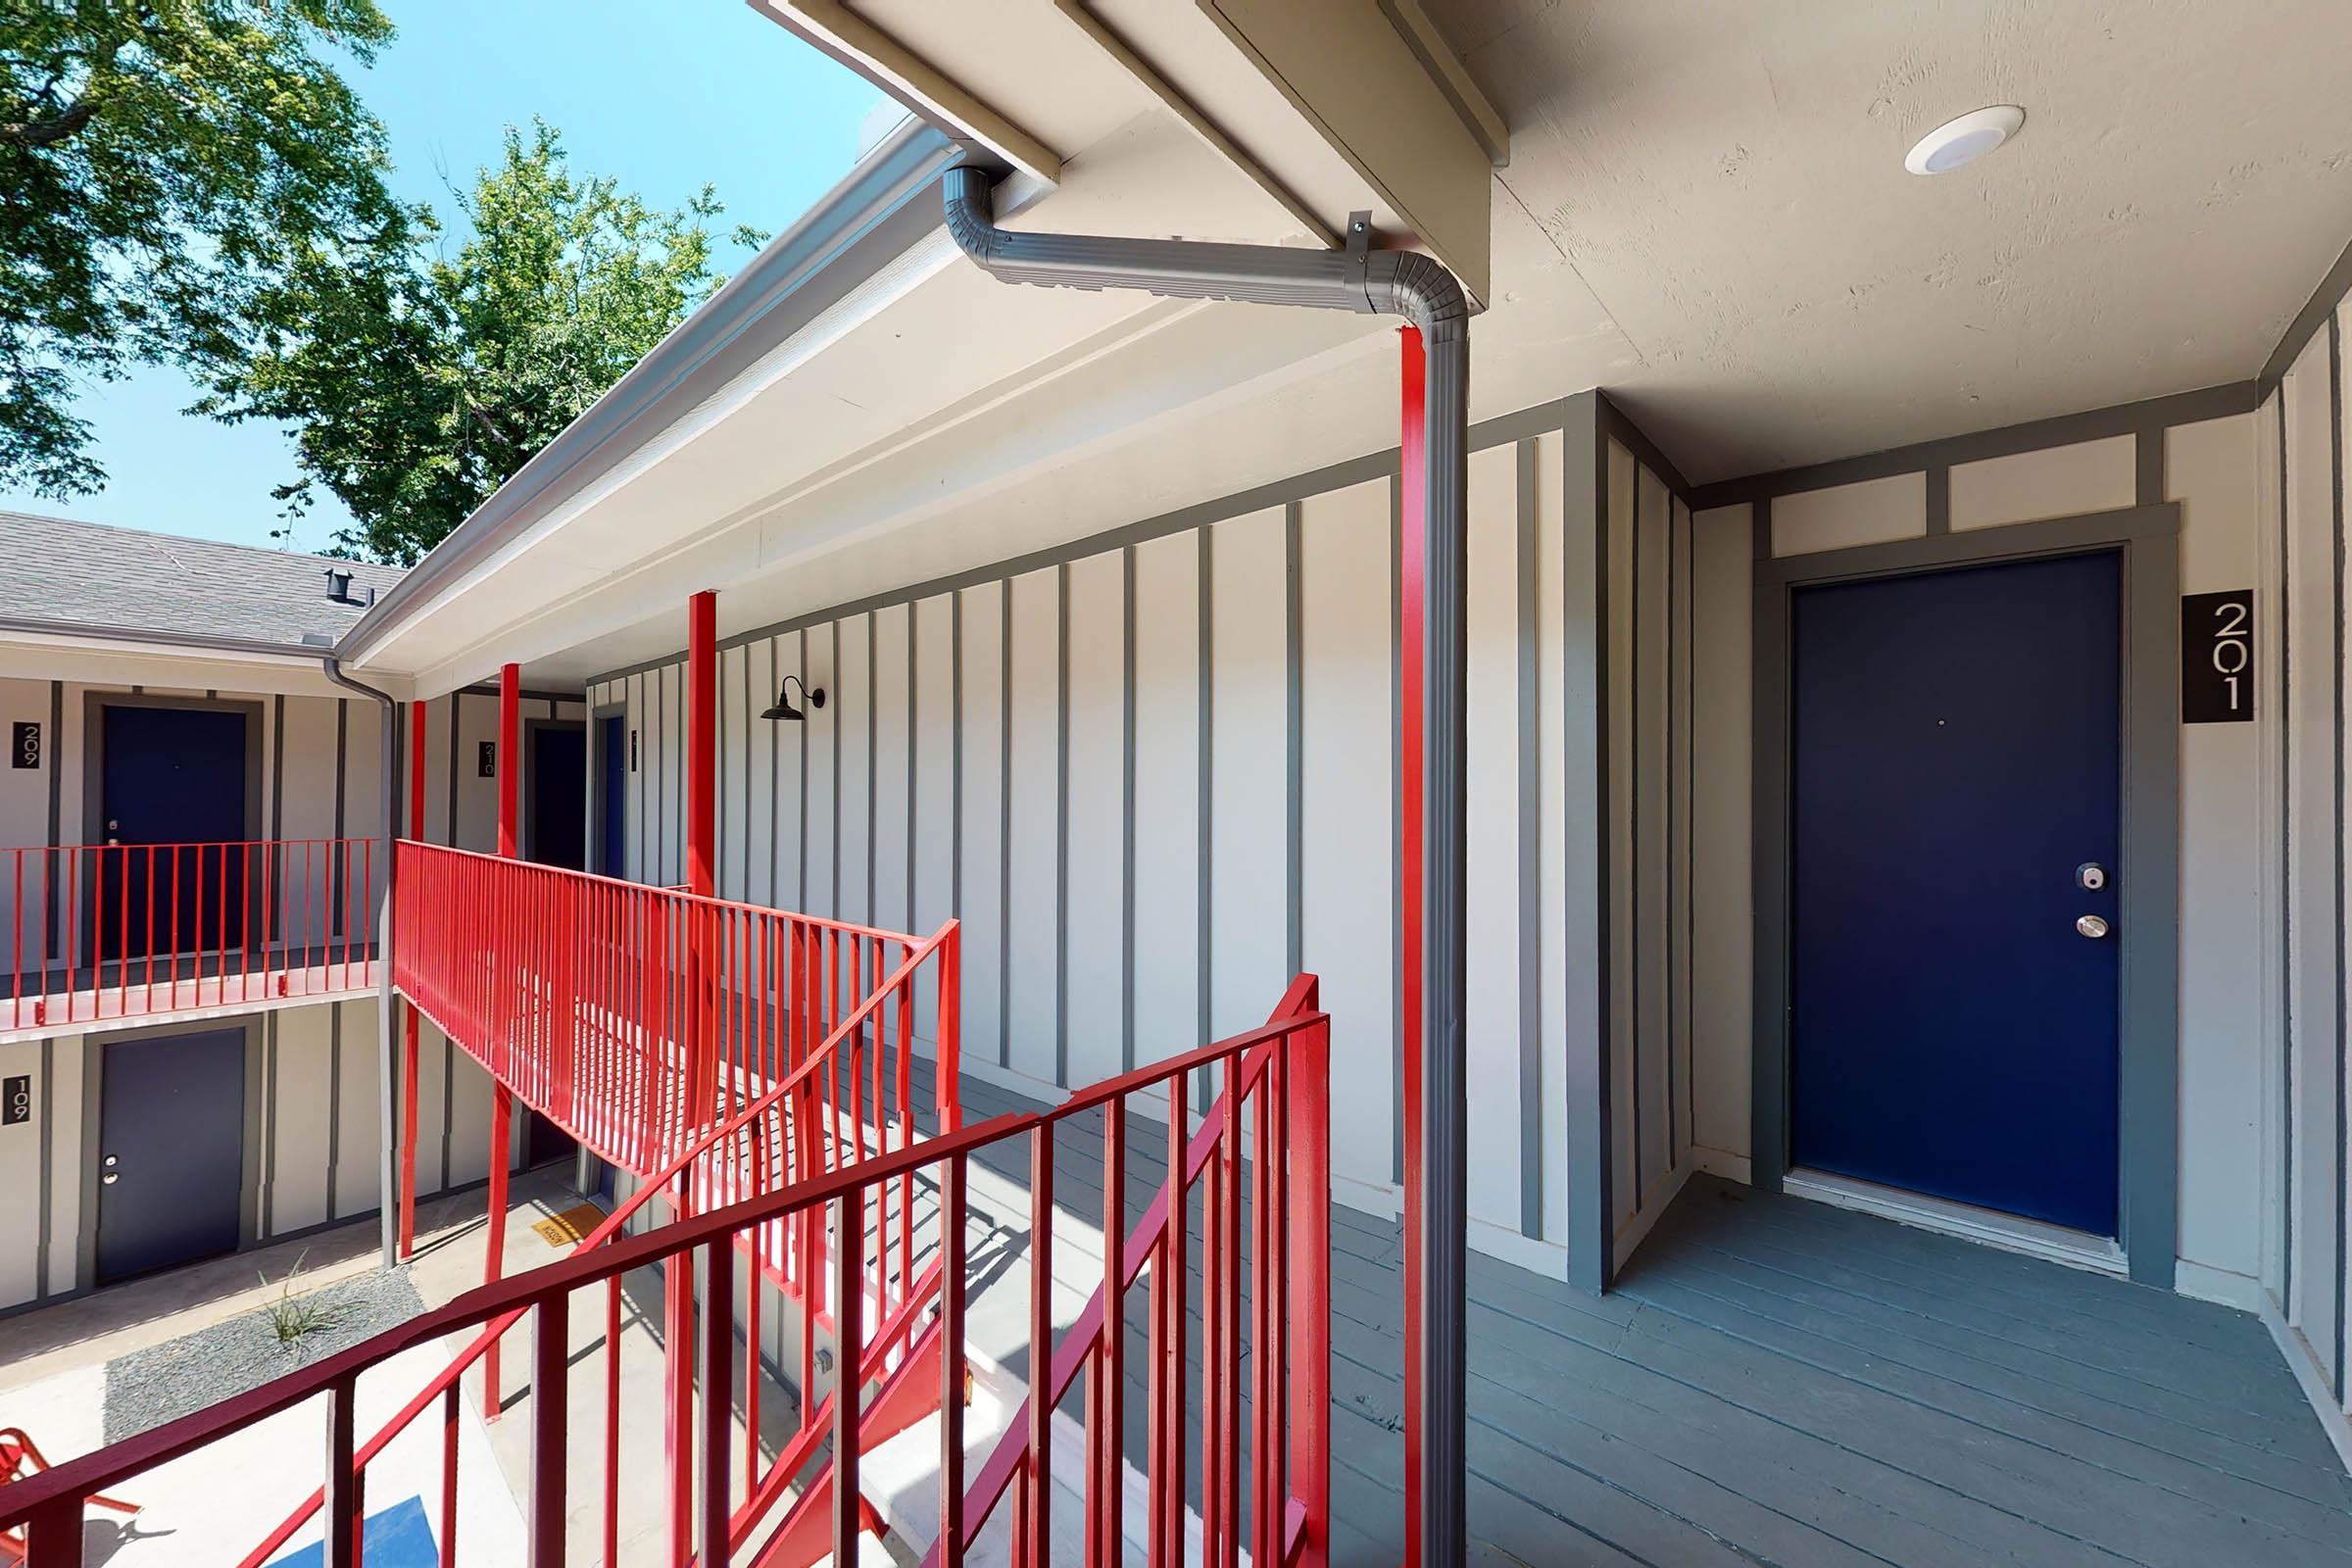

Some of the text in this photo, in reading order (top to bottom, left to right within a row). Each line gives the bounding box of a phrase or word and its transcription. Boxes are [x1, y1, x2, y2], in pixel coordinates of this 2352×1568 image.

[2213, 603, 2248, 710] 201
[24, 726, 39, 765] 209
[485, 745, 494, 775] 210
[14, 1079, 28, 1119] 109
